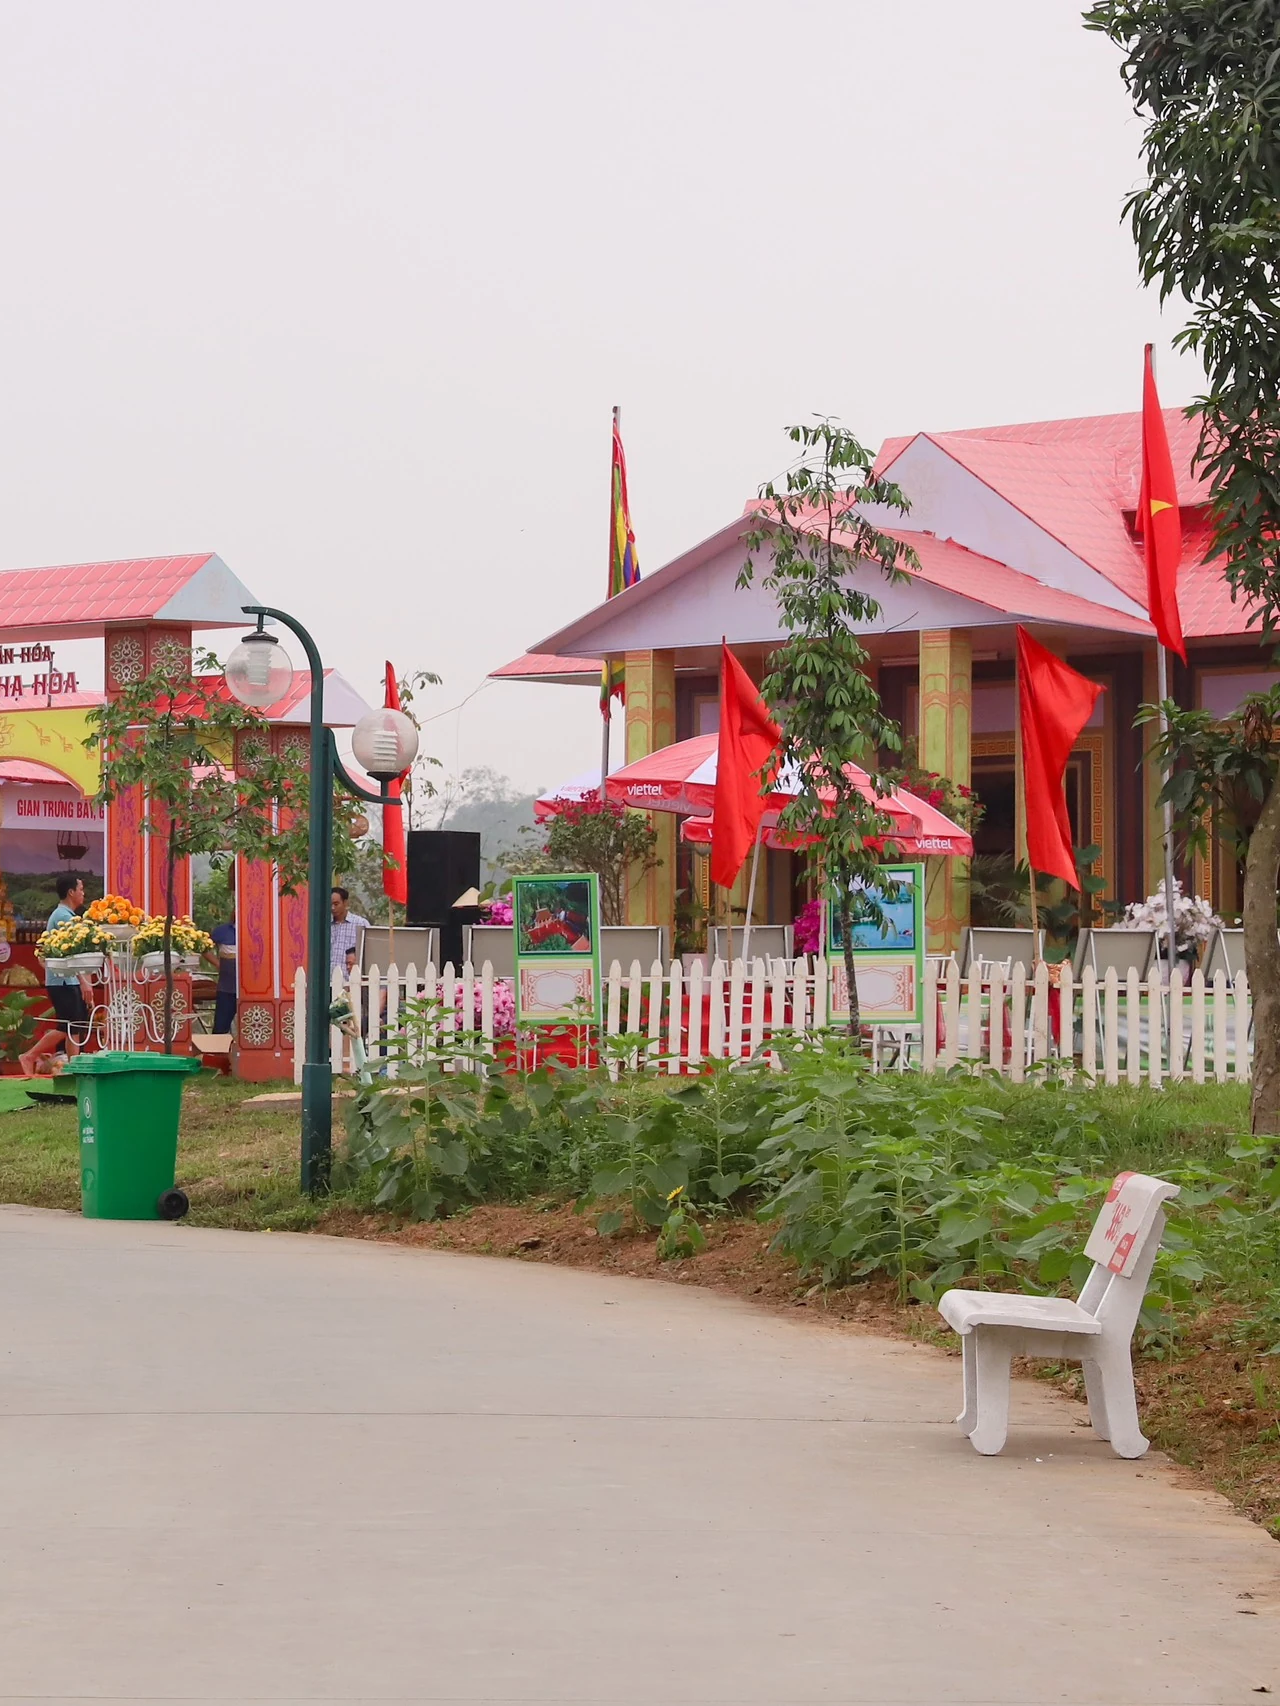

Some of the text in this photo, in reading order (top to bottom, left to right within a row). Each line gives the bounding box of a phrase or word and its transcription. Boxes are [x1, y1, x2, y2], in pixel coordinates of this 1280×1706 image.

[20, 643, 52, 663] HÓA
[32, 668, 78, 696] HÒA
[627, 784, 662, 796] viettel
[17, 800, 39, 816] GIAN
[43, 800, 73, 818] TRƯNG
[915, 838, 953, 850] viettel
